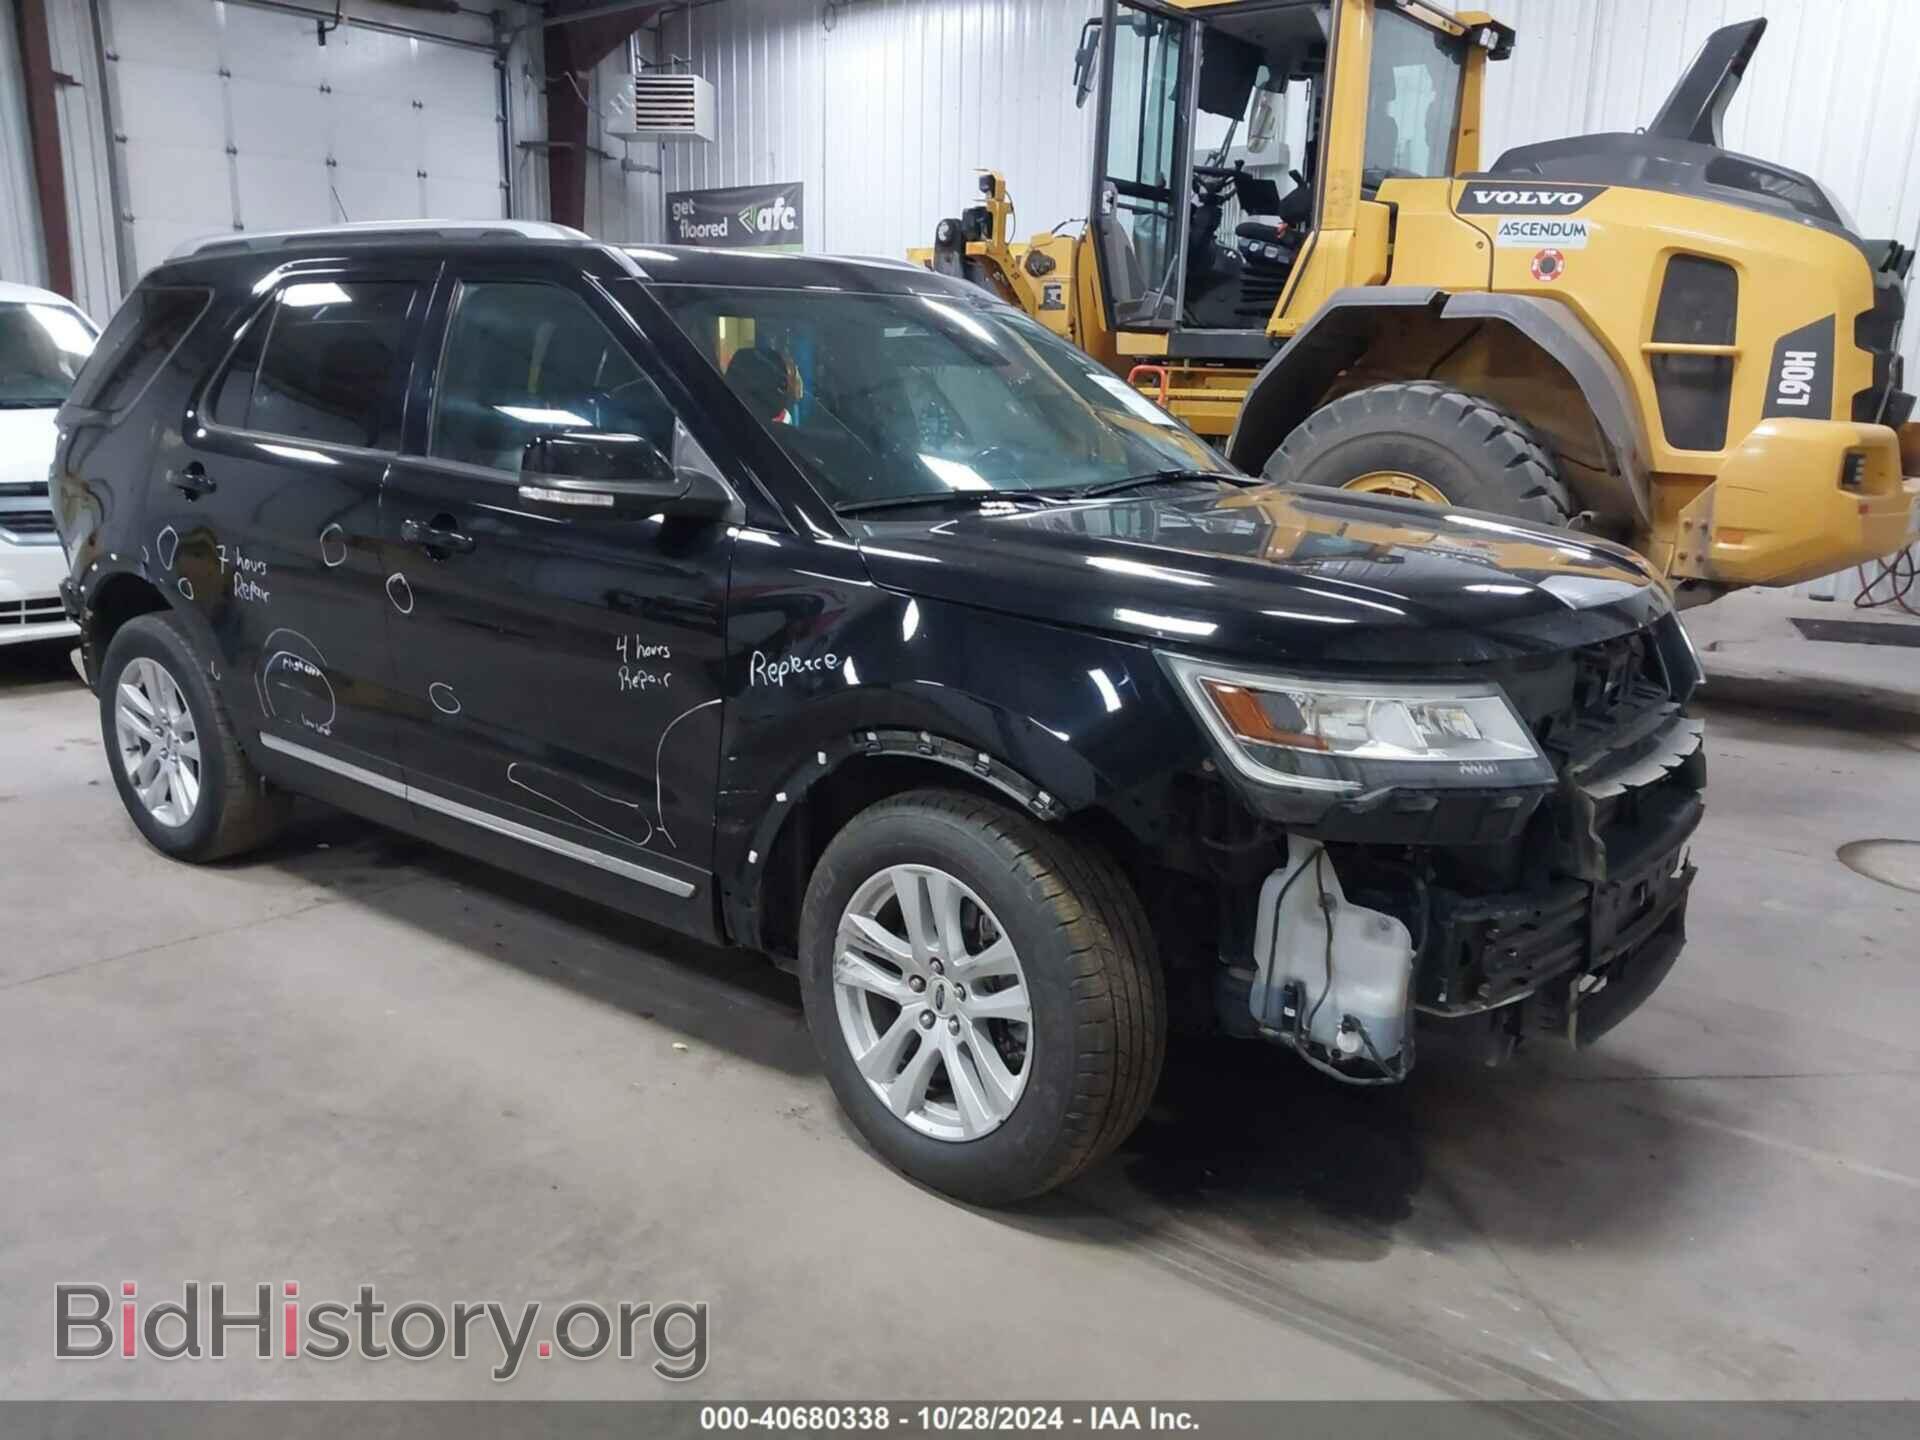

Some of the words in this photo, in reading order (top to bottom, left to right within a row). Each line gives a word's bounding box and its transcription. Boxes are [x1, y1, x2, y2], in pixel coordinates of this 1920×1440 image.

[672, 199, 695, 221] get
[1472, 190, 1584, 206] VOLVO
[679, 217, 728, 239] floored
[757, 198, 797, 231] afc
[1498, 221, 1587, 238] ASCENDUM
[1776, 350, 1818, 406] L90H
[216, 545, 230, 574] 7
[234, 546, 267, 575] hours
[233, 572, 271, 603] Repair
[615, 634, 629, 663] 4
[636, 634, 671, 659] hours
[618, 665, 672, 692] Repair
